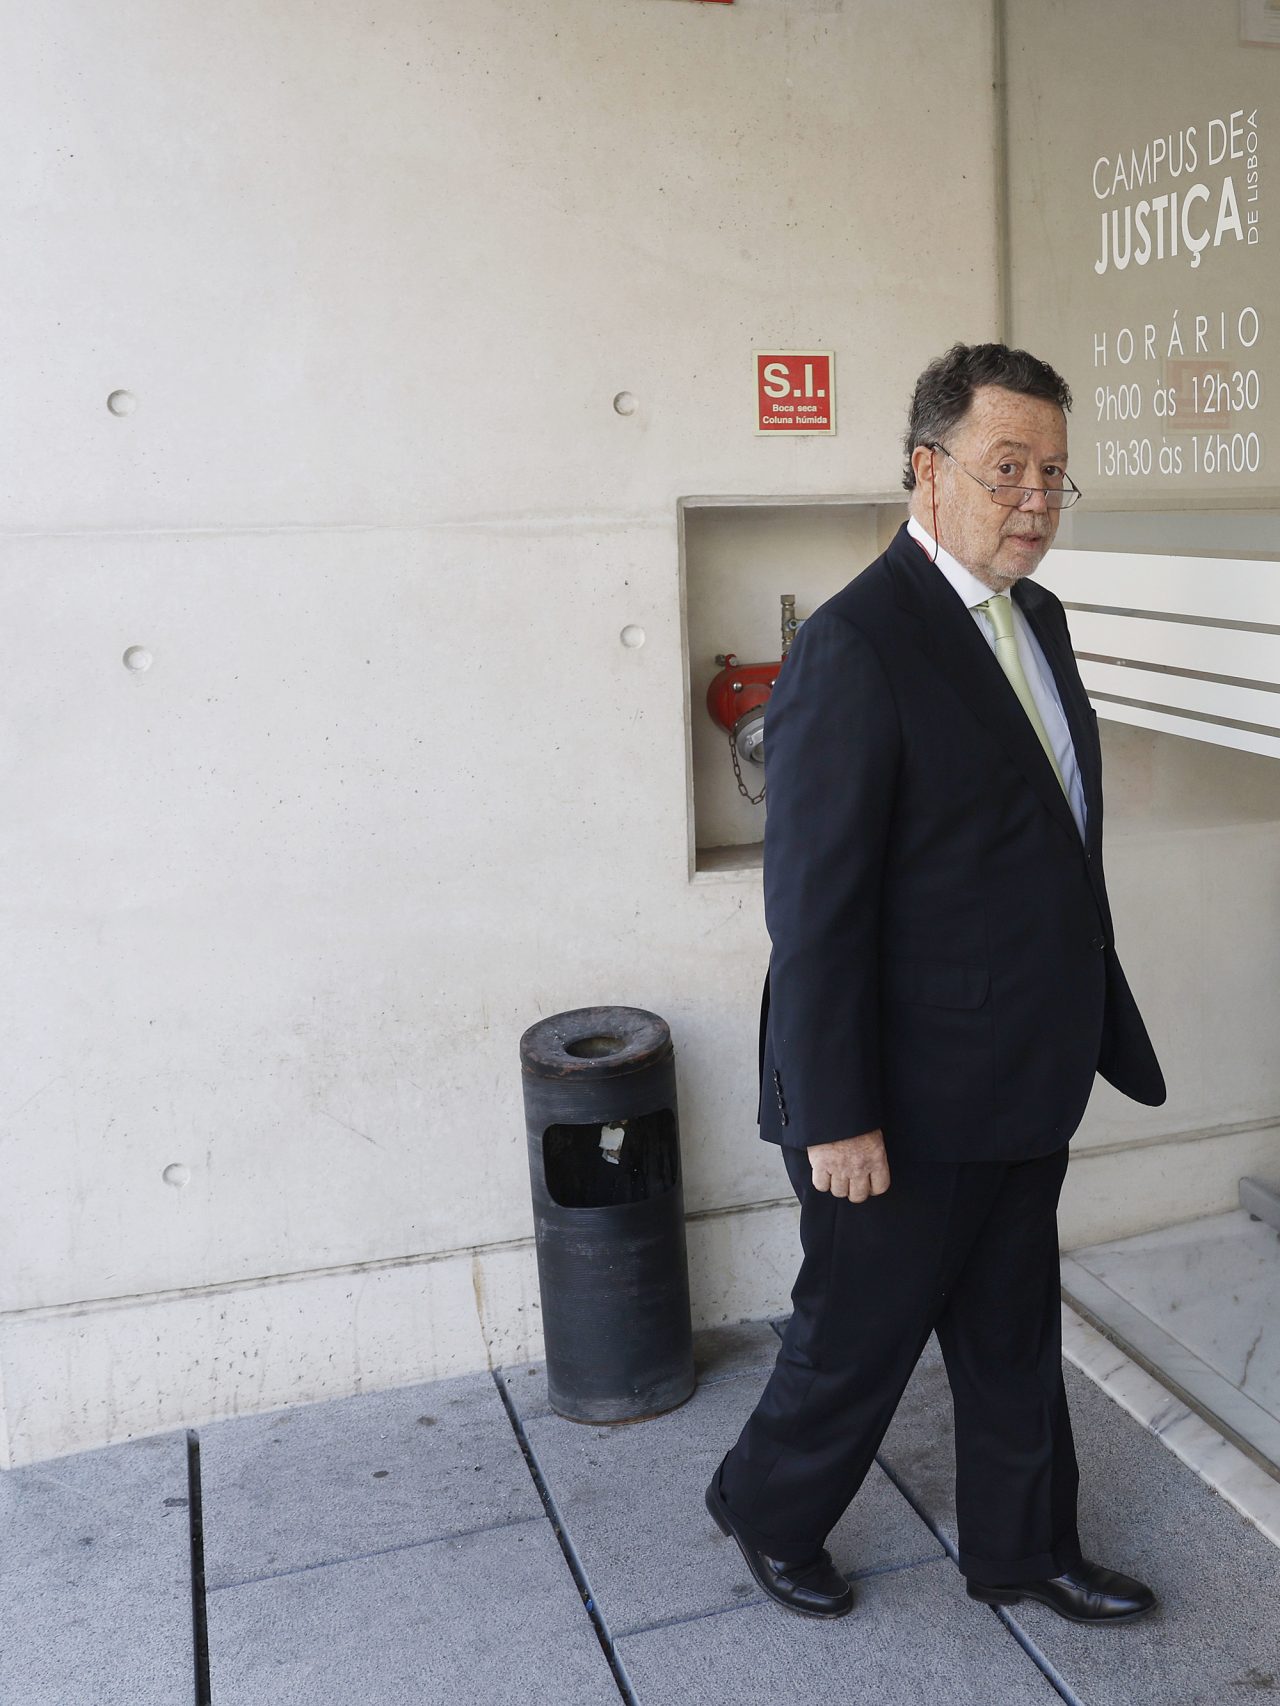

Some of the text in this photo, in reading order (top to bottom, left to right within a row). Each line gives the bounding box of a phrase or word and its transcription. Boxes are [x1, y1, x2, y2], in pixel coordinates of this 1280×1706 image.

[1093, 109, 1244, 200] CAMPUS DE
[1246, 109, 1259, 245] DE LISBOA
[1094, 176, 1244, 275] JUSTIÇA
[1094, 307, 1259, 367] HORÁRIO
[763, 363, 826, 398] S.I.
[1095, 383, 1141, 421] 9h00
[1153, 379, 1176, 416] às
[1191, 369, 1259, 413] 12h30
[762, 416, 828, 424] Coluna húmida
[772, 404, 794, 412] Boca
[1096, 432, 1260, 476] 13h30 às 16h00
